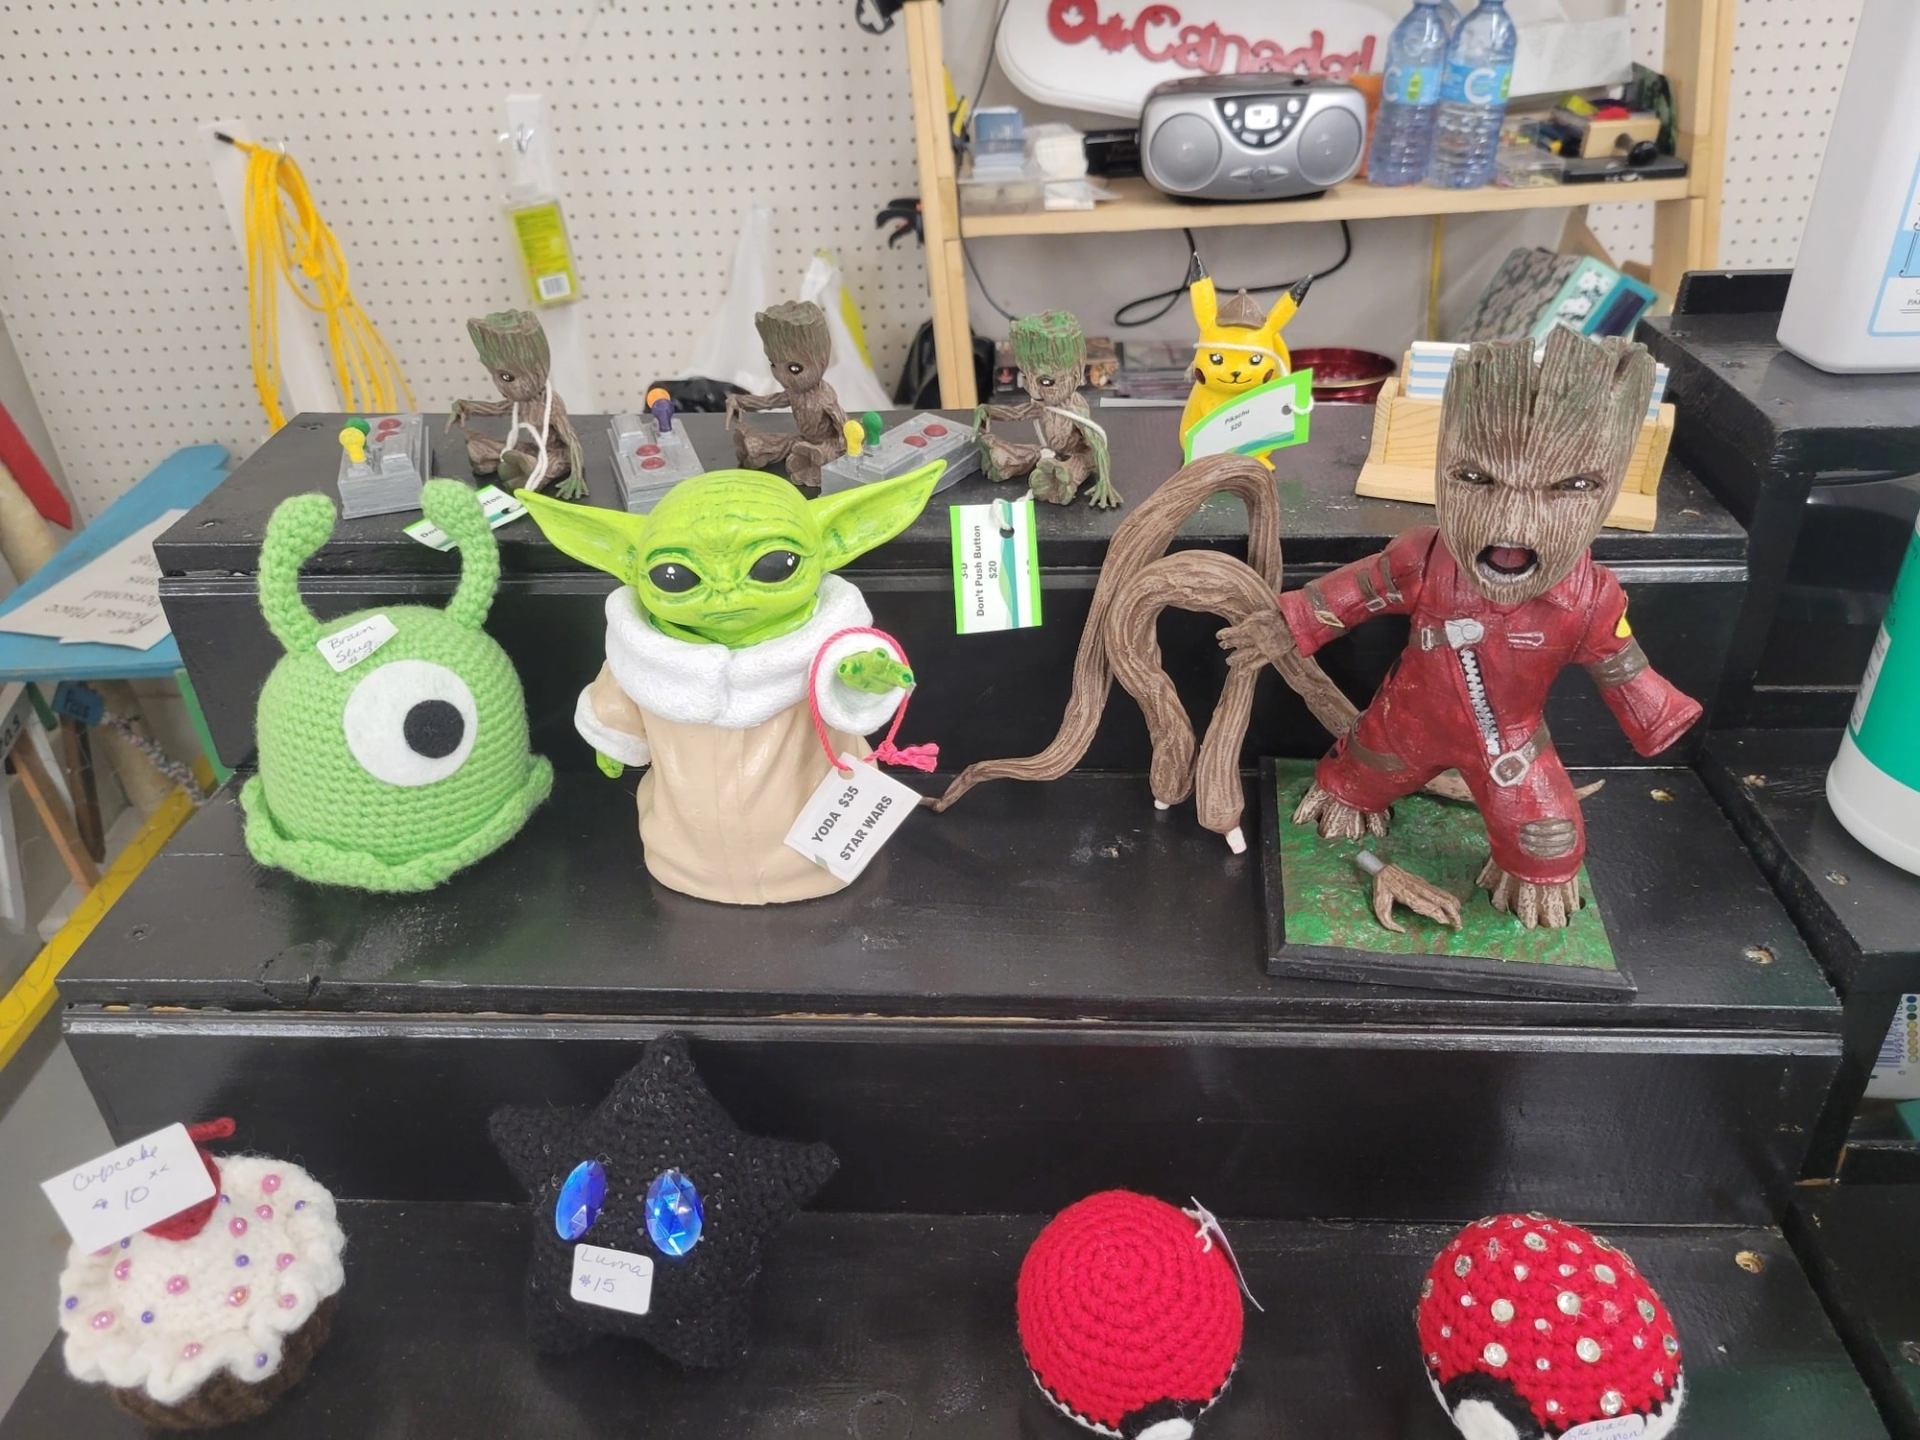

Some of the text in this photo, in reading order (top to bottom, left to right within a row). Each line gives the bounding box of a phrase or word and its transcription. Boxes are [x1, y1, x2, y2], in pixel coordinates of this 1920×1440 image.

[1224, 409, 1250, 425] Pikachu
[973, 525, 985, 617] Don't Push Button
[988, 560, 999, 579] $20
[811, 785, 860, 843] YODA $35
[839, 795, 893, 861] STAR WARS
[72, 1143, 159, 1192] Cupcake
